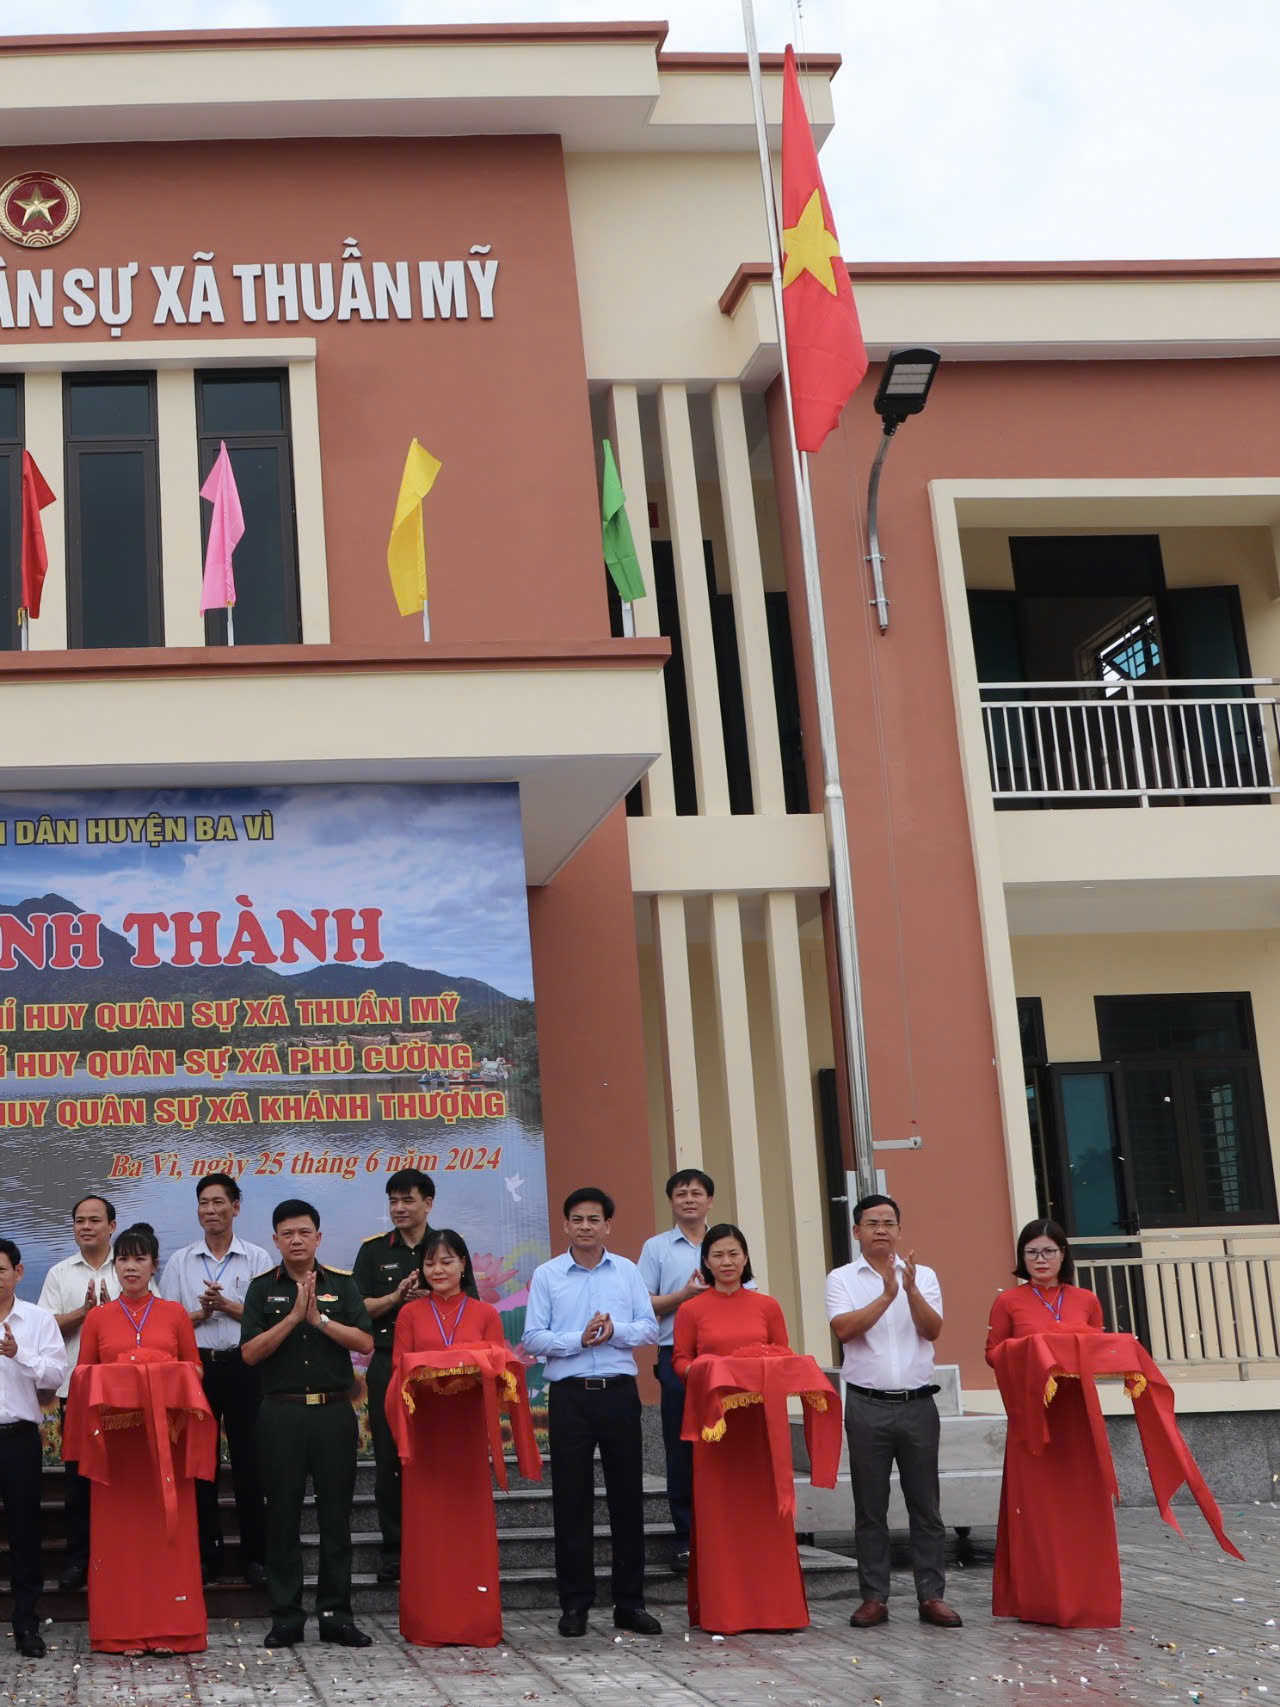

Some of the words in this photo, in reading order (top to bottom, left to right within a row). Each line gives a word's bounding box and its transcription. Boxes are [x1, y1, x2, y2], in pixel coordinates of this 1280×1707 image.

[62, 262, 138, 337] SỰ
[150, 251, 225, 325] XÃ
[233, 236, 412, 322] THUẦN
[419, 244, 499, 319] MỸ
[15, 813, 78, 844] DÂN
[86, 812, 187, 847] HUYỆN
[194, 814, 237, 842] BA
[244, 810, 274, 841] VÌ
[122, 894, 386, 968] THÀNH
[23, 1003, 89, 1031] HUY
[95, 996, 185, 1030] QUÂN
[191, 998, 241, 1033] SỰ
[244, 991, 290, 1027] XÃ
[294, 989, 401, 1026] THUẦN
[408, 991, 461, 1023] MỸ
[14, 1051, 80, 1079] HUY
[86, 1046, 176, 1080] QUÂN
[184, 1045, 232, 1080] SỰ
[235, 1042, 282, 1076] XÃ
[288, 1041, 355, 1074] PHÚ
[363, 1040, 473, 1073] CƯỜNG
[56, 1094, 147, 1128] QUÂN
[154, 1095, 203, 1130] SỰ
[206, 1091, 253, 1125] XÃ
[260, 1090, 370, 1124] KHÁNH
[378, 1091, 507, 1124] THƯỢNG
[108, 1154, 143, 1179] Ba
[153, 1152, 183, 1181] Vì,
[190, 1150, 249, 1180] ngày
[254, 1152, 286, 1176] 25
[290, 1149, 358, 1179] tháng
[365, 1149, 380, 1173] 6
[386, 1148, 438, 1173] năm
[444, 1146, 503, 1171] 2024
